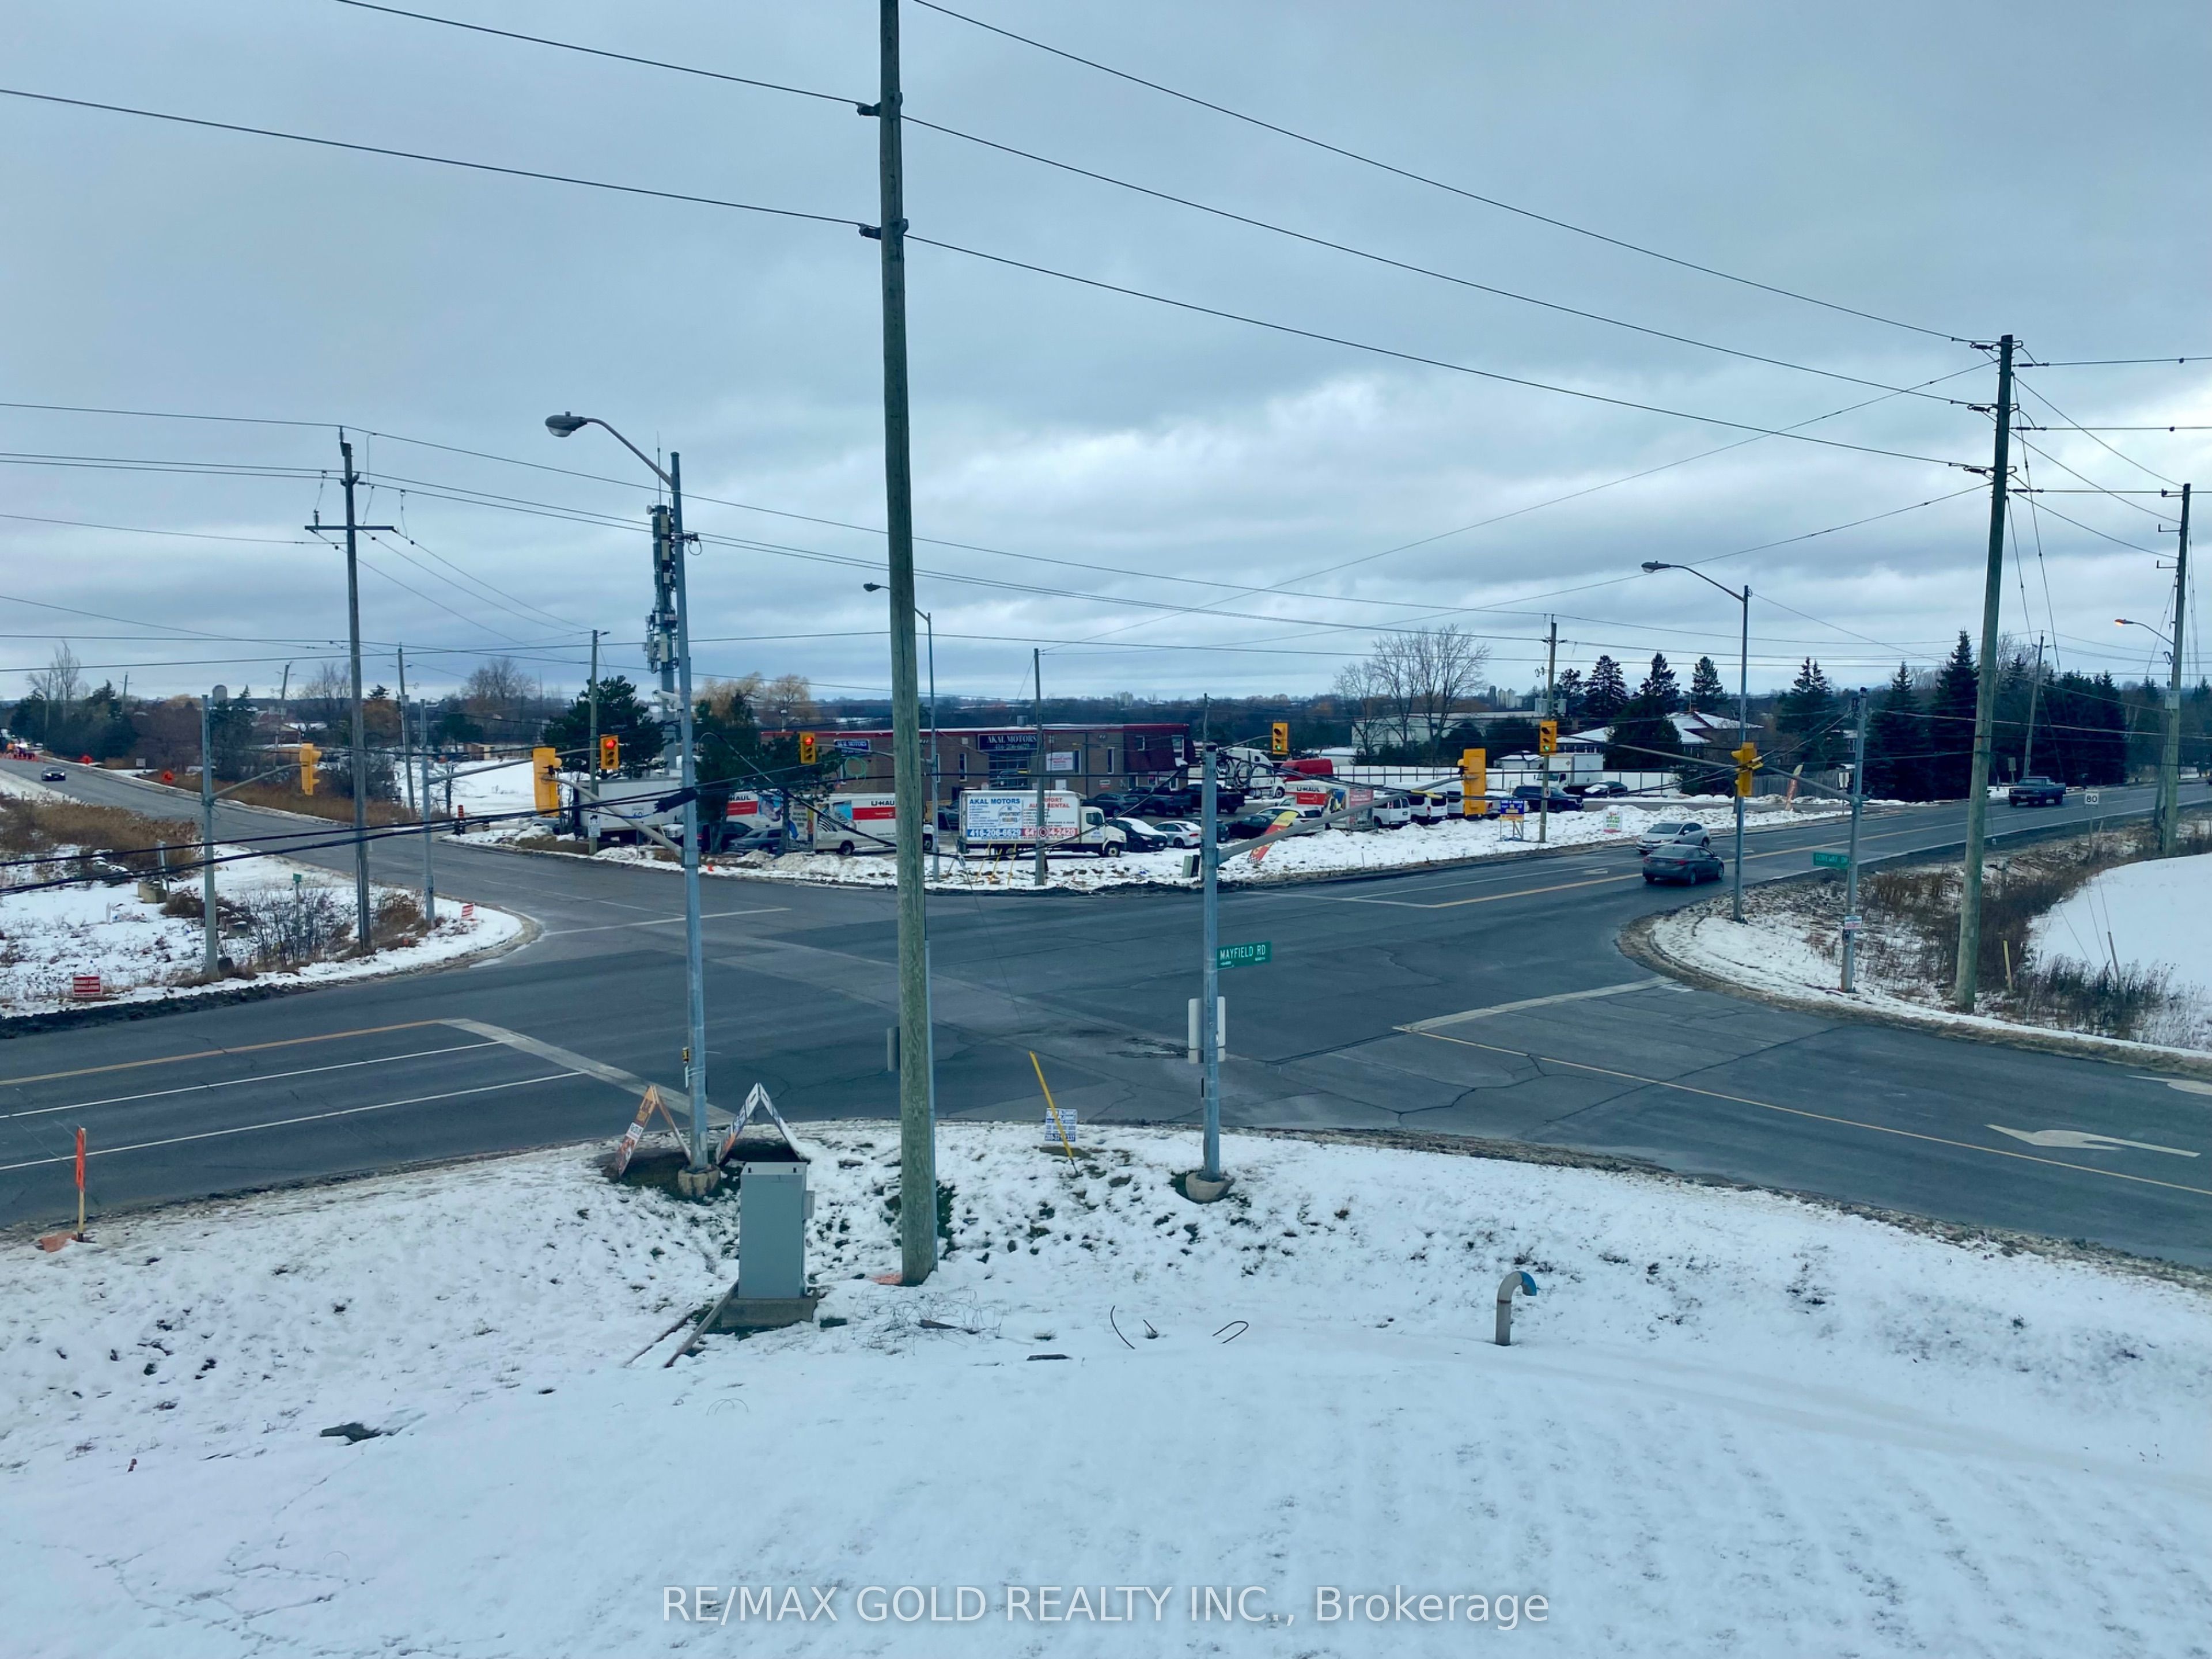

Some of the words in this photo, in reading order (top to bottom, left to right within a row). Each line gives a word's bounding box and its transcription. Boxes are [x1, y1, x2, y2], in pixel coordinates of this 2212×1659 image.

[987, 735, 1006, 743] AKAL
[1007, 734, 1037, 743] MOTORS
[1220, 946, 1253, 960] MAYFIELD
[1257, 944, 1266, 955] RD
